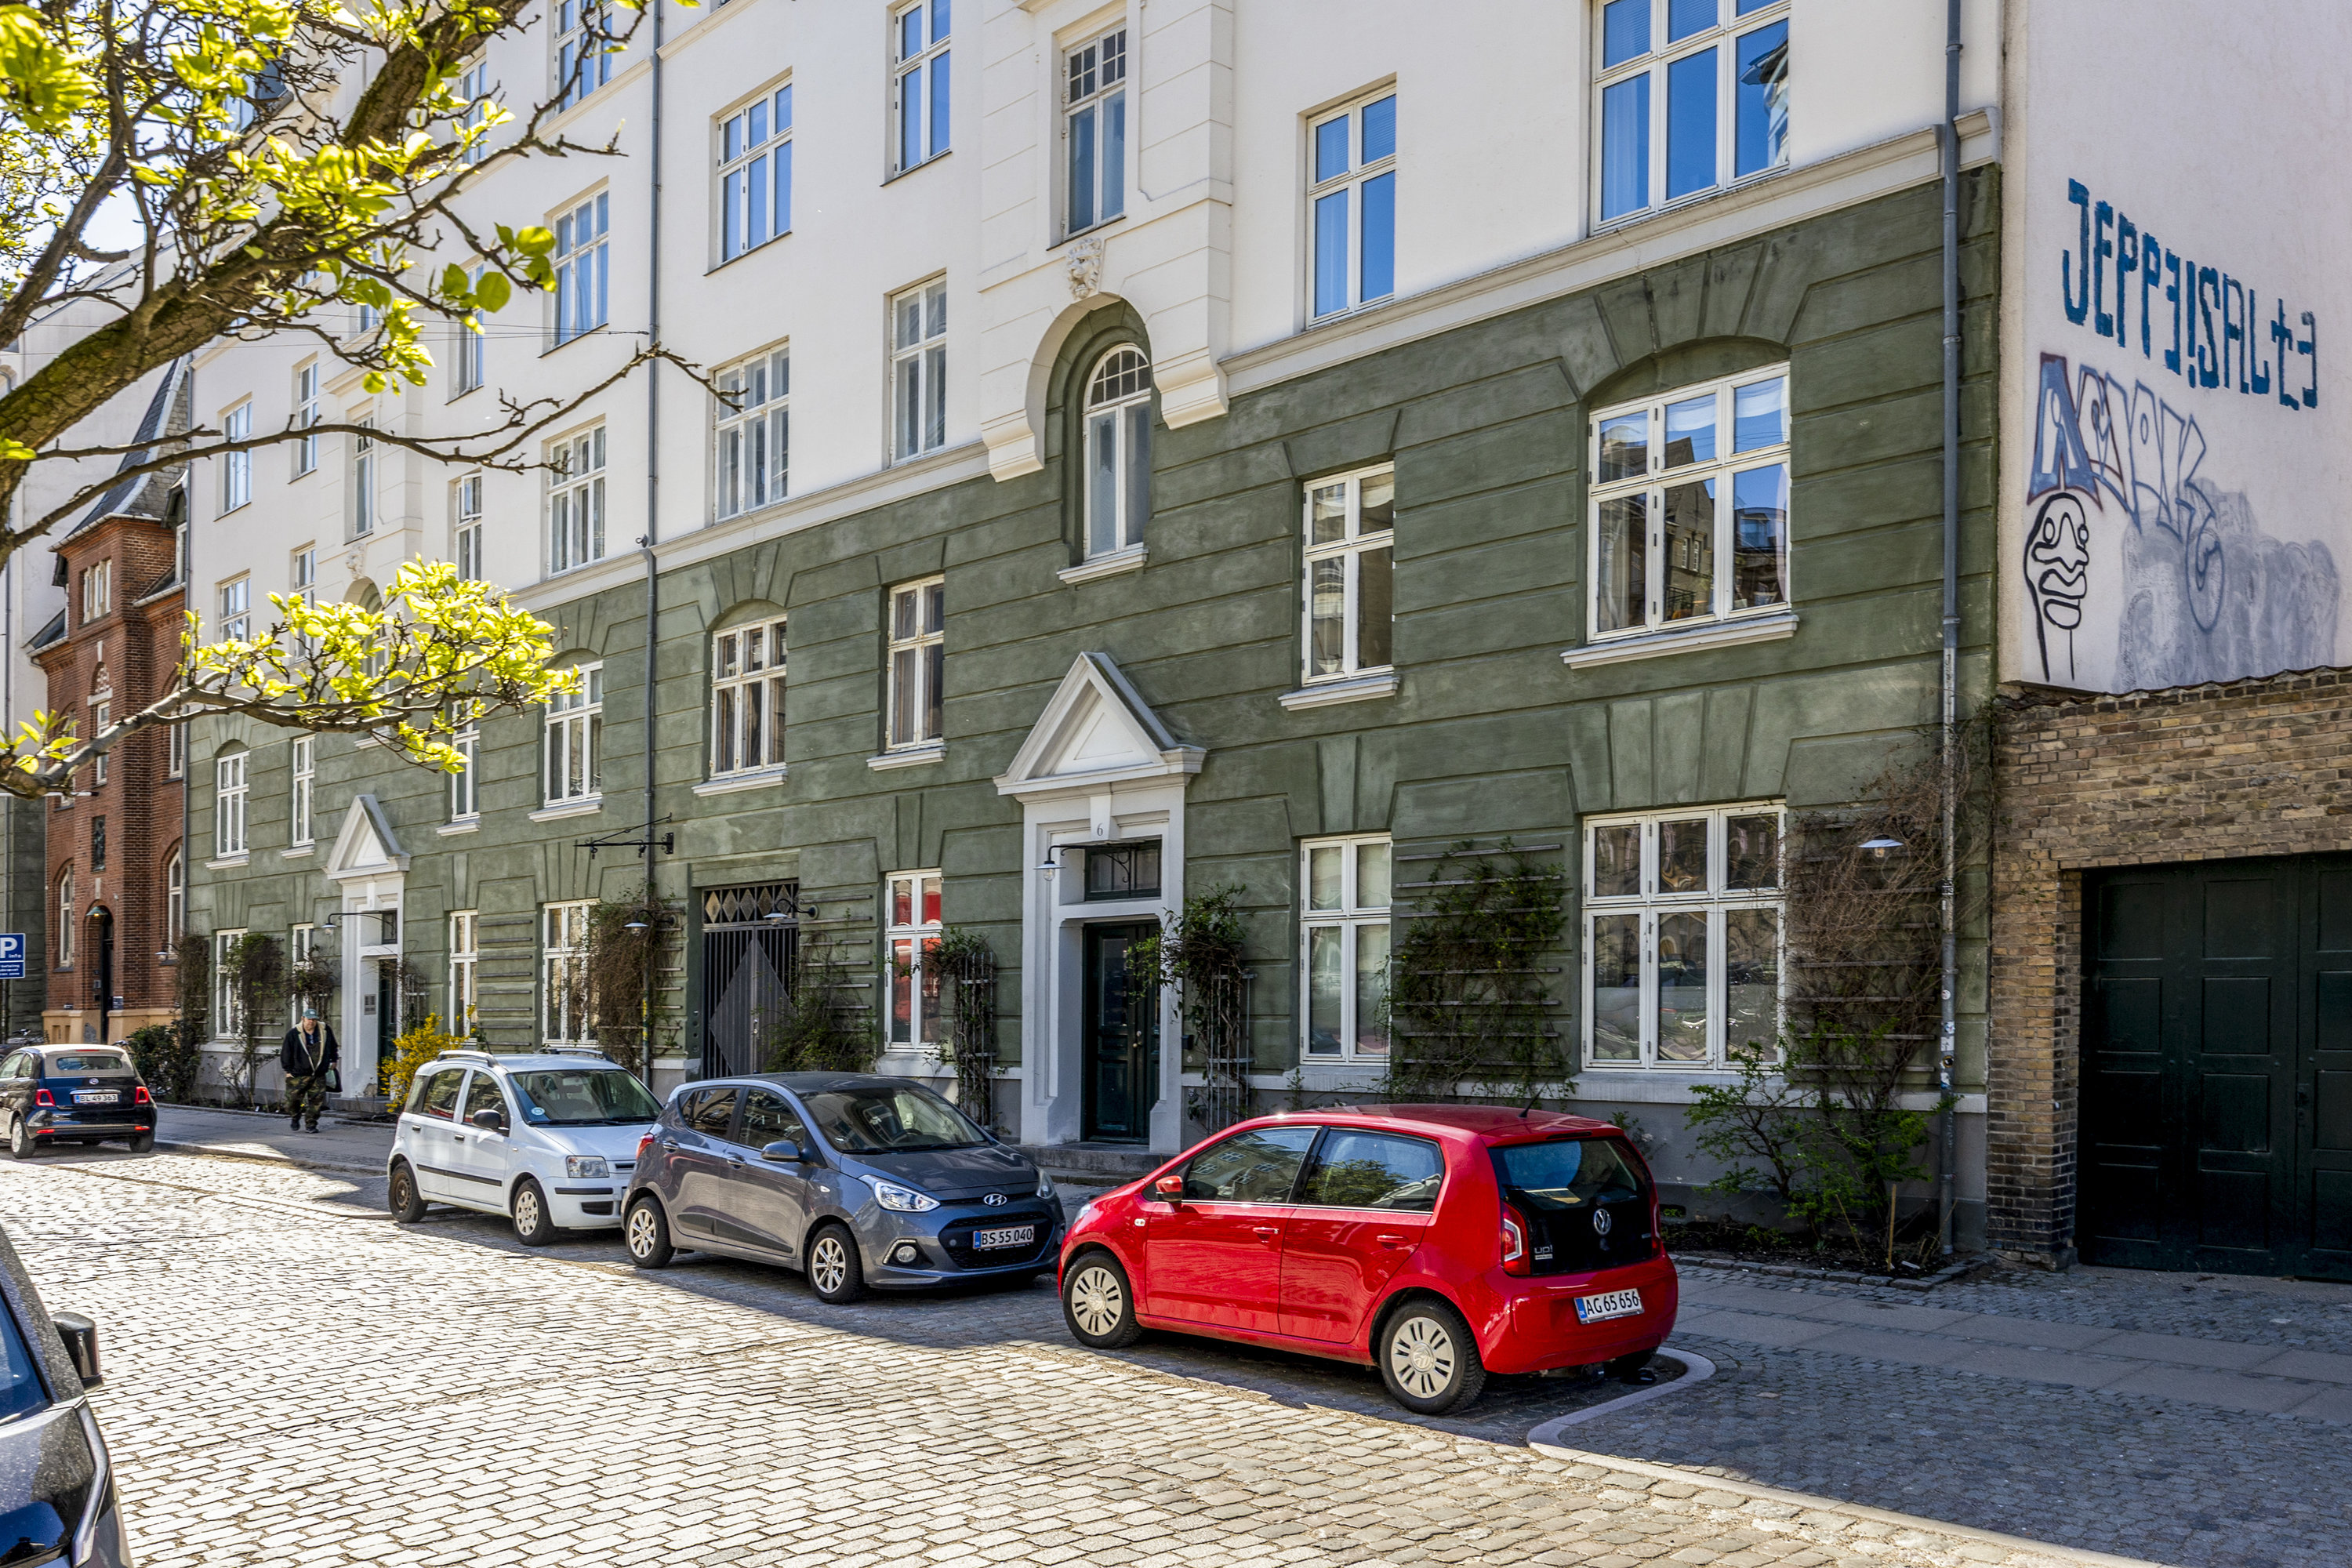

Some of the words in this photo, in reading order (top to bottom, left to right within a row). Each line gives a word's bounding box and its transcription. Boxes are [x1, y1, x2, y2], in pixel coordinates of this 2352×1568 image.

[1097, 822, 1103, 837] 6
[0, 937, 18, 958] P
[982, 1232, 996, 1245] BS
[998, 1231, 1011, 1243] 55
[1014, 1229, 1033, 1241] 040
[1534, 1244, 1553, 1254] up!
[1586, 1298, 1602, 1315] AG
[1603, 1295, 1617, 1312] 65
[1619, 1291, 1639, 1308] 656
